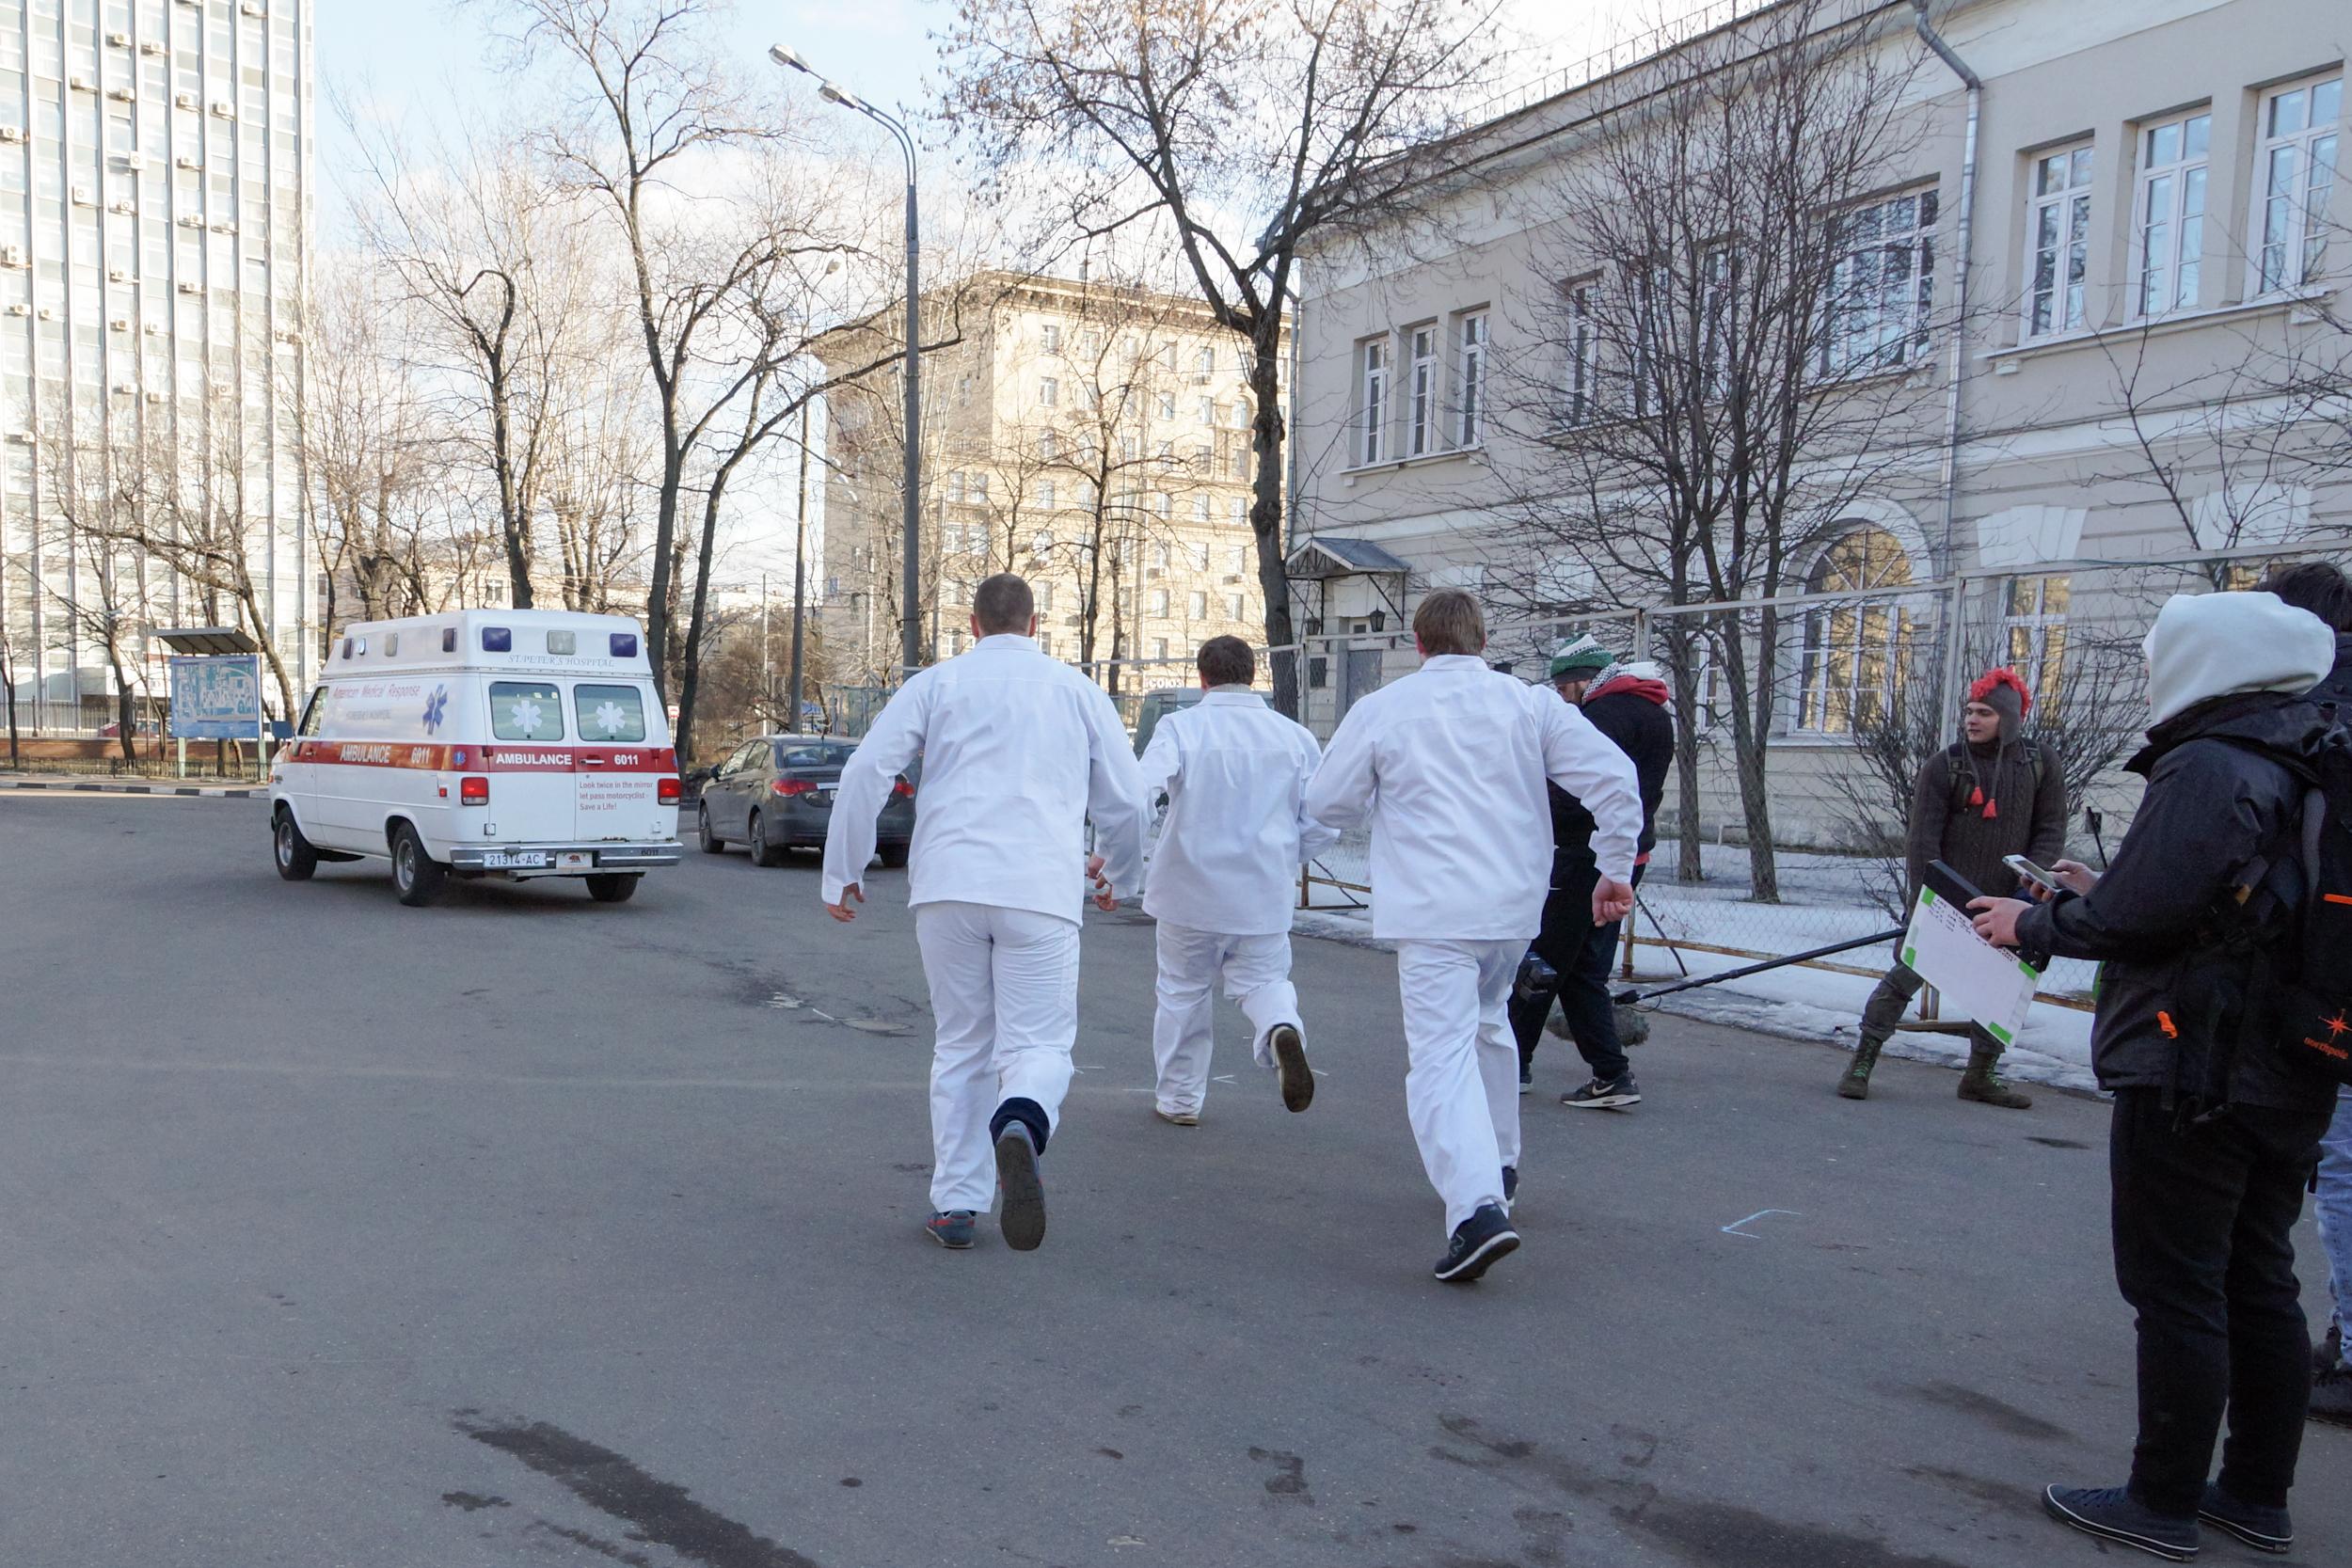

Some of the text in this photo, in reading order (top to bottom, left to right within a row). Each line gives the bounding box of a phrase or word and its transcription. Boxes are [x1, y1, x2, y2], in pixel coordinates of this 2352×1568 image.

[564, 657, 614, 668] HOSPITAL
[333, 684, 421, 699] American Medical Response
[340, 744, 430, 764] AMBULANCE 6011
[496, 753, 639, 765] AMBULANCE 6011
[606, 792, 645, 800] motorcyclist
